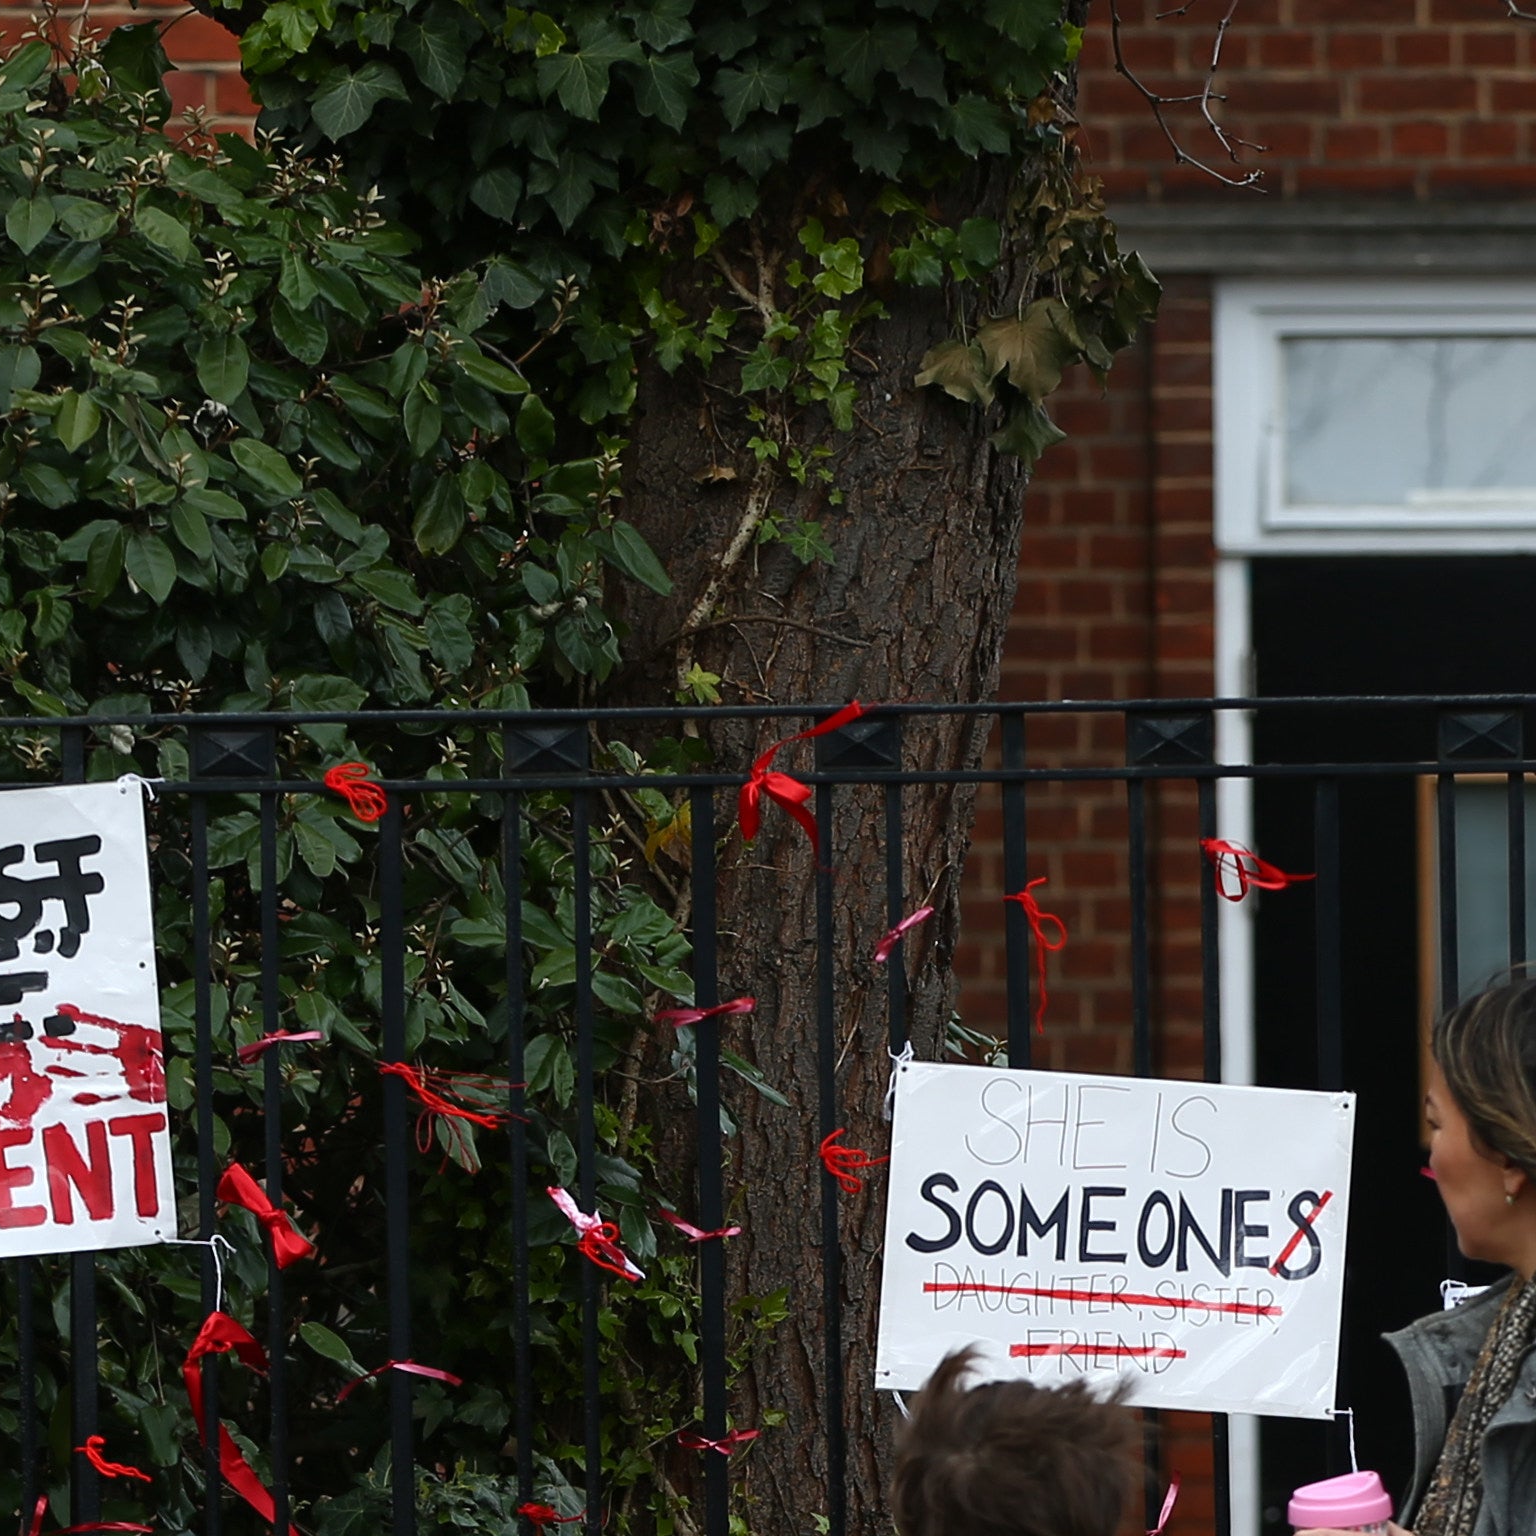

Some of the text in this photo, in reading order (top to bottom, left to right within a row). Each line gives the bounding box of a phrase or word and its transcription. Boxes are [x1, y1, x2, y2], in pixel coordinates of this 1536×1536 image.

[964, 1077, 1218, 1178] SHE IS
[1026, 1329, 1178, 1375] FRIEND
